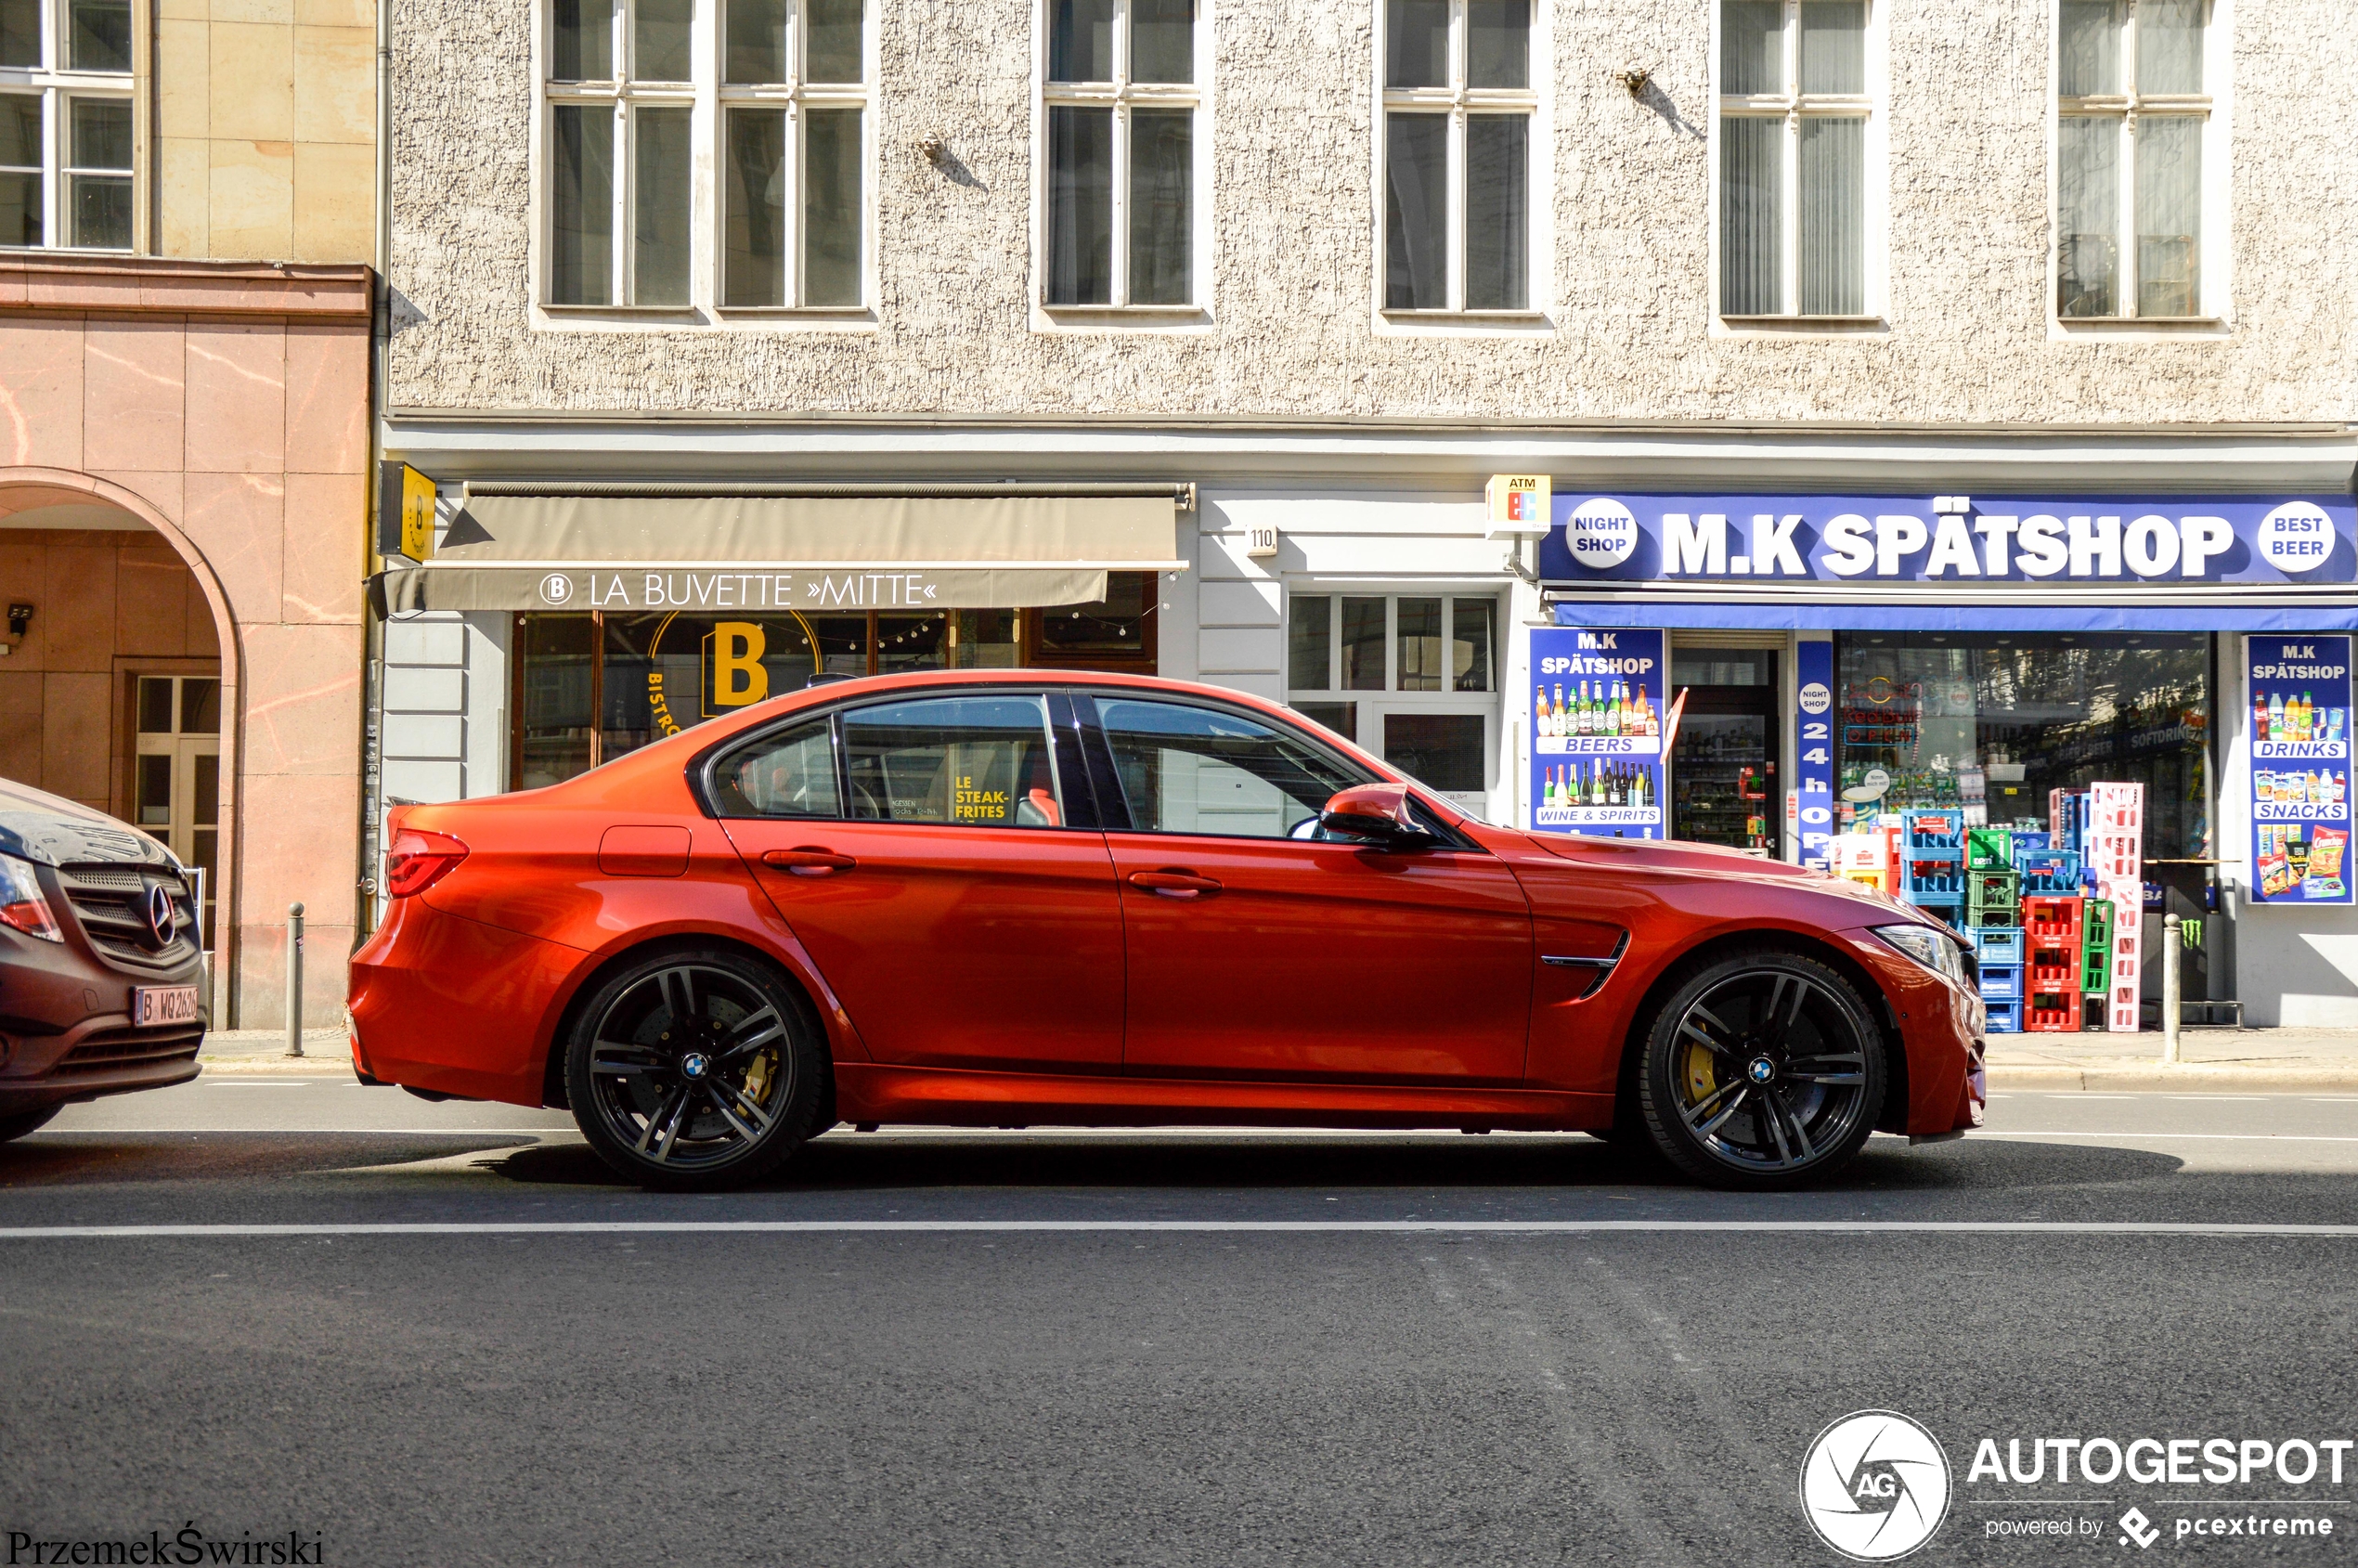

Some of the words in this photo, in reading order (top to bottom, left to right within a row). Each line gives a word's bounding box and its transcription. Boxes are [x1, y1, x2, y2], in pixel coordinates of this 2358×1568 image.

[1509, 478, 1535, 487] ATM
[417, 495, 423, 530] B
[1575, 517, 1629, 530] NIGHT
[2274, 517, 2323, 532] BEST
[1250, 529, 1272, 547] 110
[1663, 513, 1807, 575] M.K
[1821, 496, 2235, 577] SPÄTSHOP
[1576, 538, 1627, 551] SHOP
[2273, 540, 2325, 555] BEER
[590, 574, 630, 605] LA
[645, 574, 792, 606] BUVETTE
[1577, 633, 1617, 649] M.K
[2282, 645, 2316, 659] M.K
[714, 621, 769, 706] B
[1541, 653, 1653, 674] SPÄTSHOP
[2252, 662, 2346, 679] SPÄTSHOP
[1848, 729, 1911, 742] OPEN
[1565, 738, 1633, 752] BEERS
[2261, 743, 2339, 757] DRINKS
[955, 776, 971, 788] LE
[955, 791, 1009, 804] STEAK-
[955, 805, 1005, 818] FRITES
[1541, 810, 1578, 821] WINE
[1584, 810, 1593, 821] &
[1600, 810, 1656, 821] SPIRITS
[2260, 804, 2343, 818] SNACKS
[144, 993, 152, 1020] B
